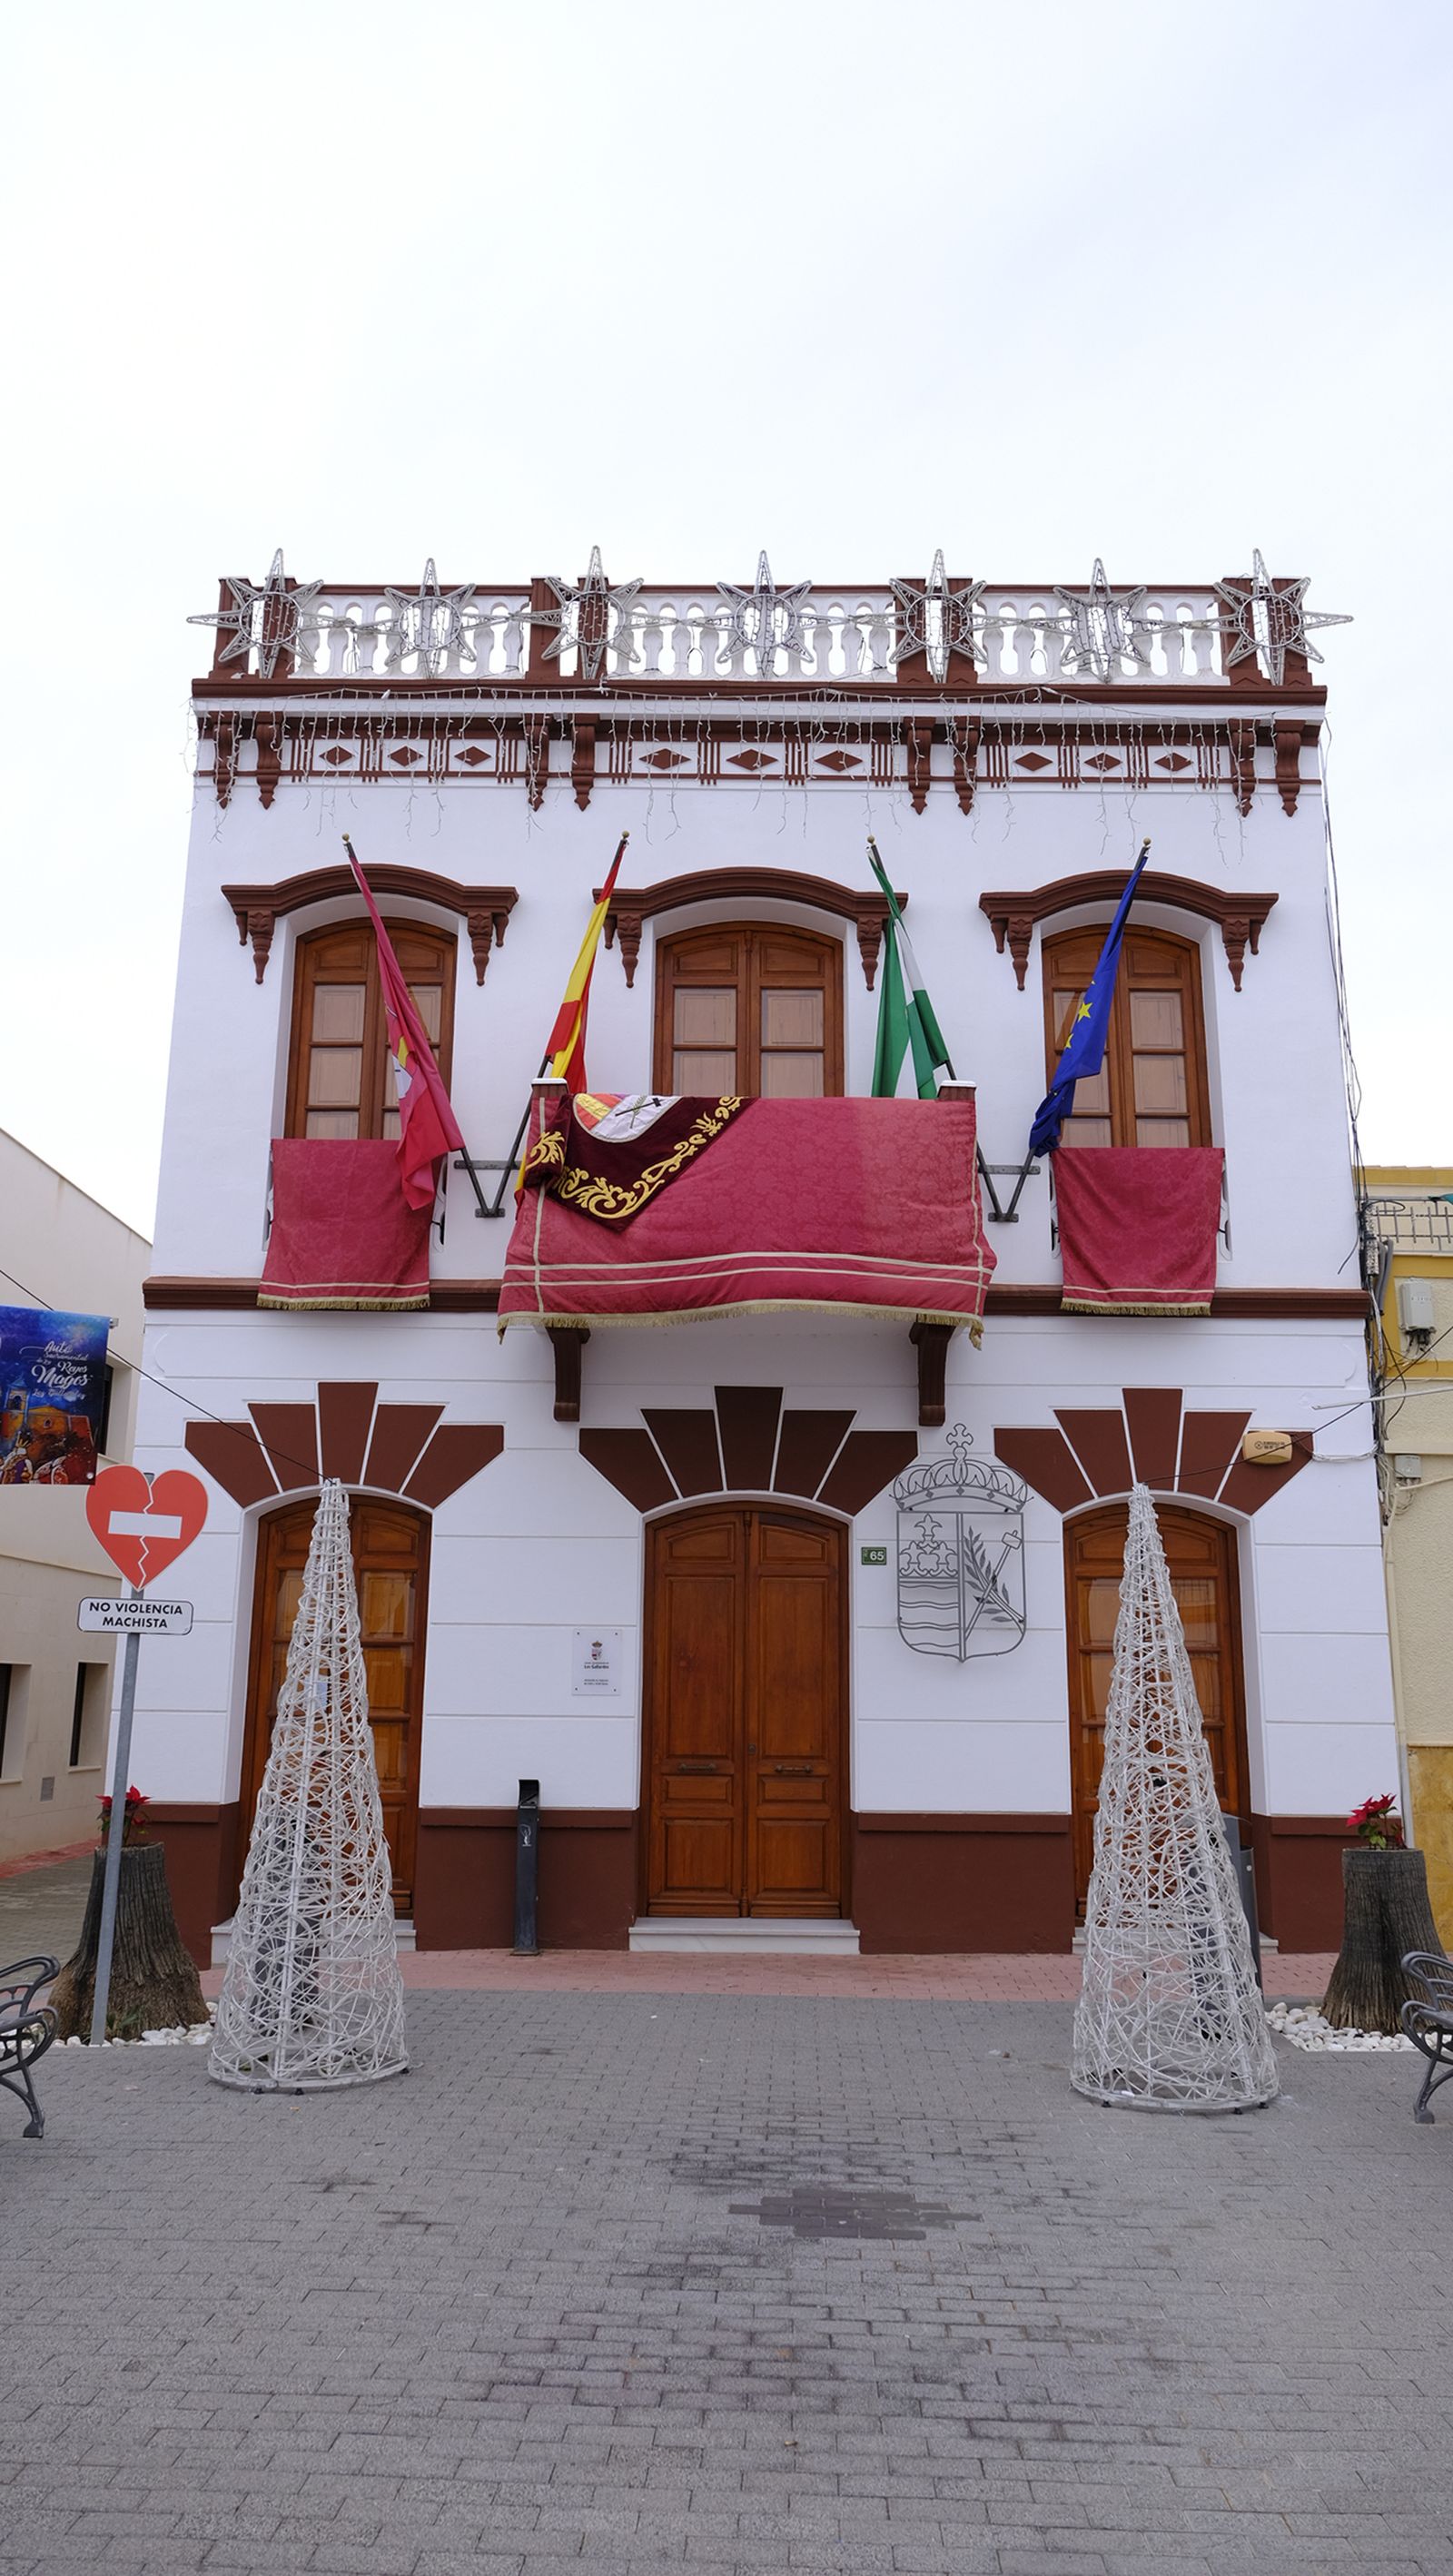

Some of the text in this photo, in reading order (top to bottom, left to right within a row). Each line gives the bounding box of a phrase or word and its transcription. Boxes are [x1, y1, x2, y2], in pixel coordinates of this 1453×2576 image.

[57, 1360, 87, 1376] Reyes
[31, 1365, 88, 1389] Magos
[870, 1551, 884, 1561] 65
[89, 1602, 183, 1614] NO VIOLENCIA
[102, 1616, 168, 1628] MACHISTA
